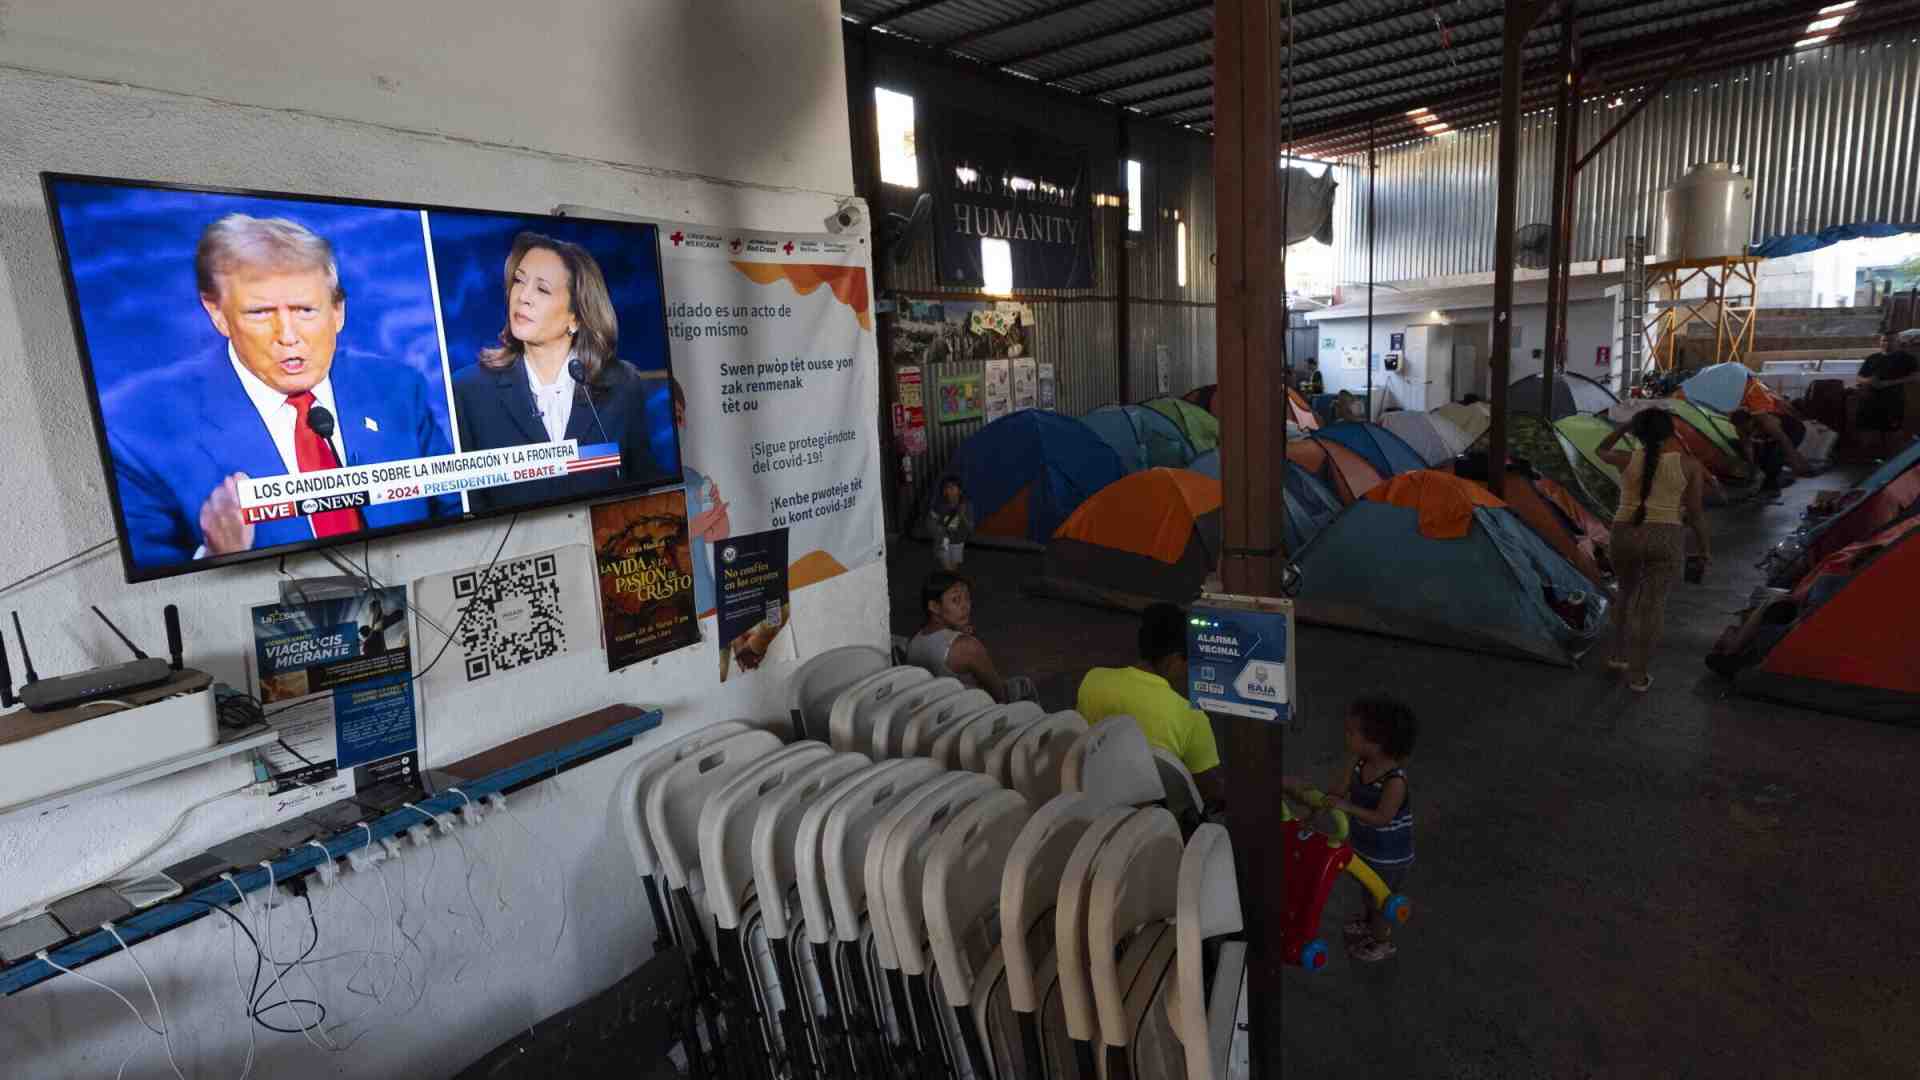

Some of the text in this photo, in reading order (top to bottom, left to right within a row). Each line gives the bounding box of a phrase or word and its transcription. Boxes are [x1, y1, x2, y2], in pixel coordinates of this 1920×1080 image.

[953, 203, 1079, 244] HUMANITY
[716, 306, 730, 317] es
[732, 306, 748, 317] un
[752, 304, 776, 317] acto
[778, 303, 792, 317] de
[705, 322, 748, 336] mismo
[720, 357, 854, 376] Swen pwòp tèt ouse yon
[721, 376, 803, 395] zak renmenak
[722, 398, 758, 414] tèt ou
[752, 430, 856, 459] ¡Sigue protegiéndote
[753, 450, 823, 474] del covid-19!
[254, 444, 575, 500] LOS CANDIDATOS SOBRE LA INMIGRACIÓN Y LA FRONTERA
[387, 465, 556, 500] 2024 PRESIDENTIAL DEBATE
[318, 493, 366, 511] NEWS
[770, 492, 810, 513] ¡Kenbe
[812, 481, 849, 504] pwoteje
[248, 504, 290, 522] LIVE
[772, 496, 856, 527] ou kont covid-19!
[612, 558, 647, 576] VIDA
[724, 568, 738, 578] No
[638, 574, 692, 601] CRISTO
[265, 634, 344, 658] VIACRUCIS
[1198, 633, 1238, 646] ALARMA
[275, 644, 351, 669] MIGRANTE
[1199, 644, 1240, 657] VECINAL
